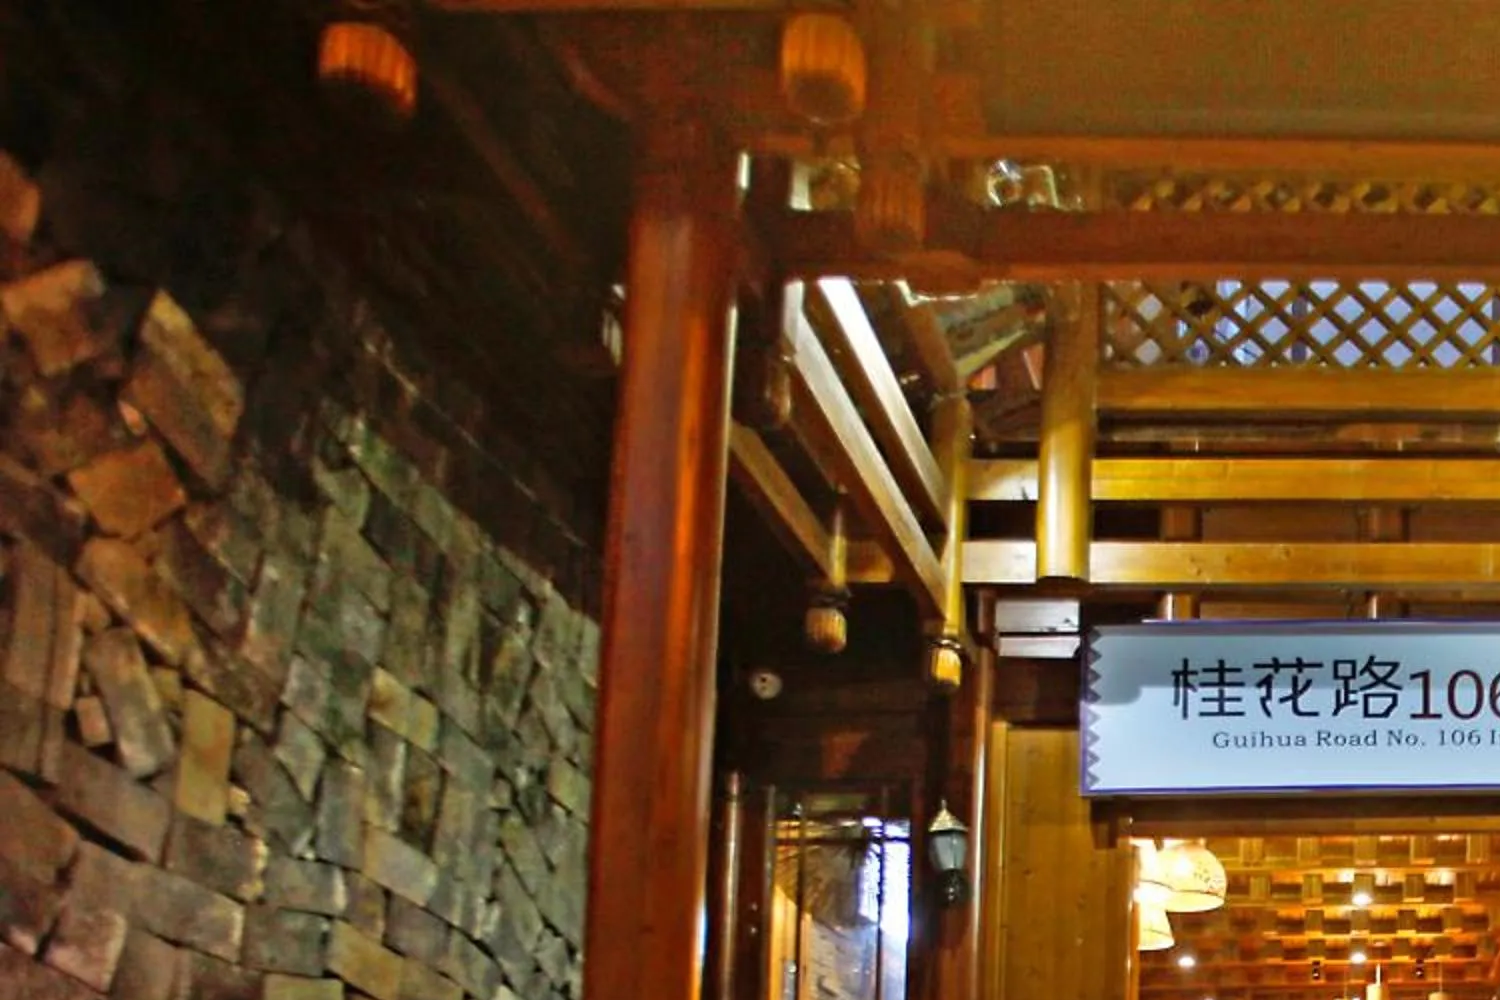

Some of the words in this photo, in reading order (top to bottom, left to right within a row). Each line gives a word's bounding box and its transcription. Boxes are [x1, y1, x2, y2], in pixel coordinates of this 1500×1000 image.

[1212, 731, 1307, 750] Guihua
[1316, 729, 1378, 748] Road
[1386, 729, 1426, 747] No.
[1438, 729, 1482, 747] 106
